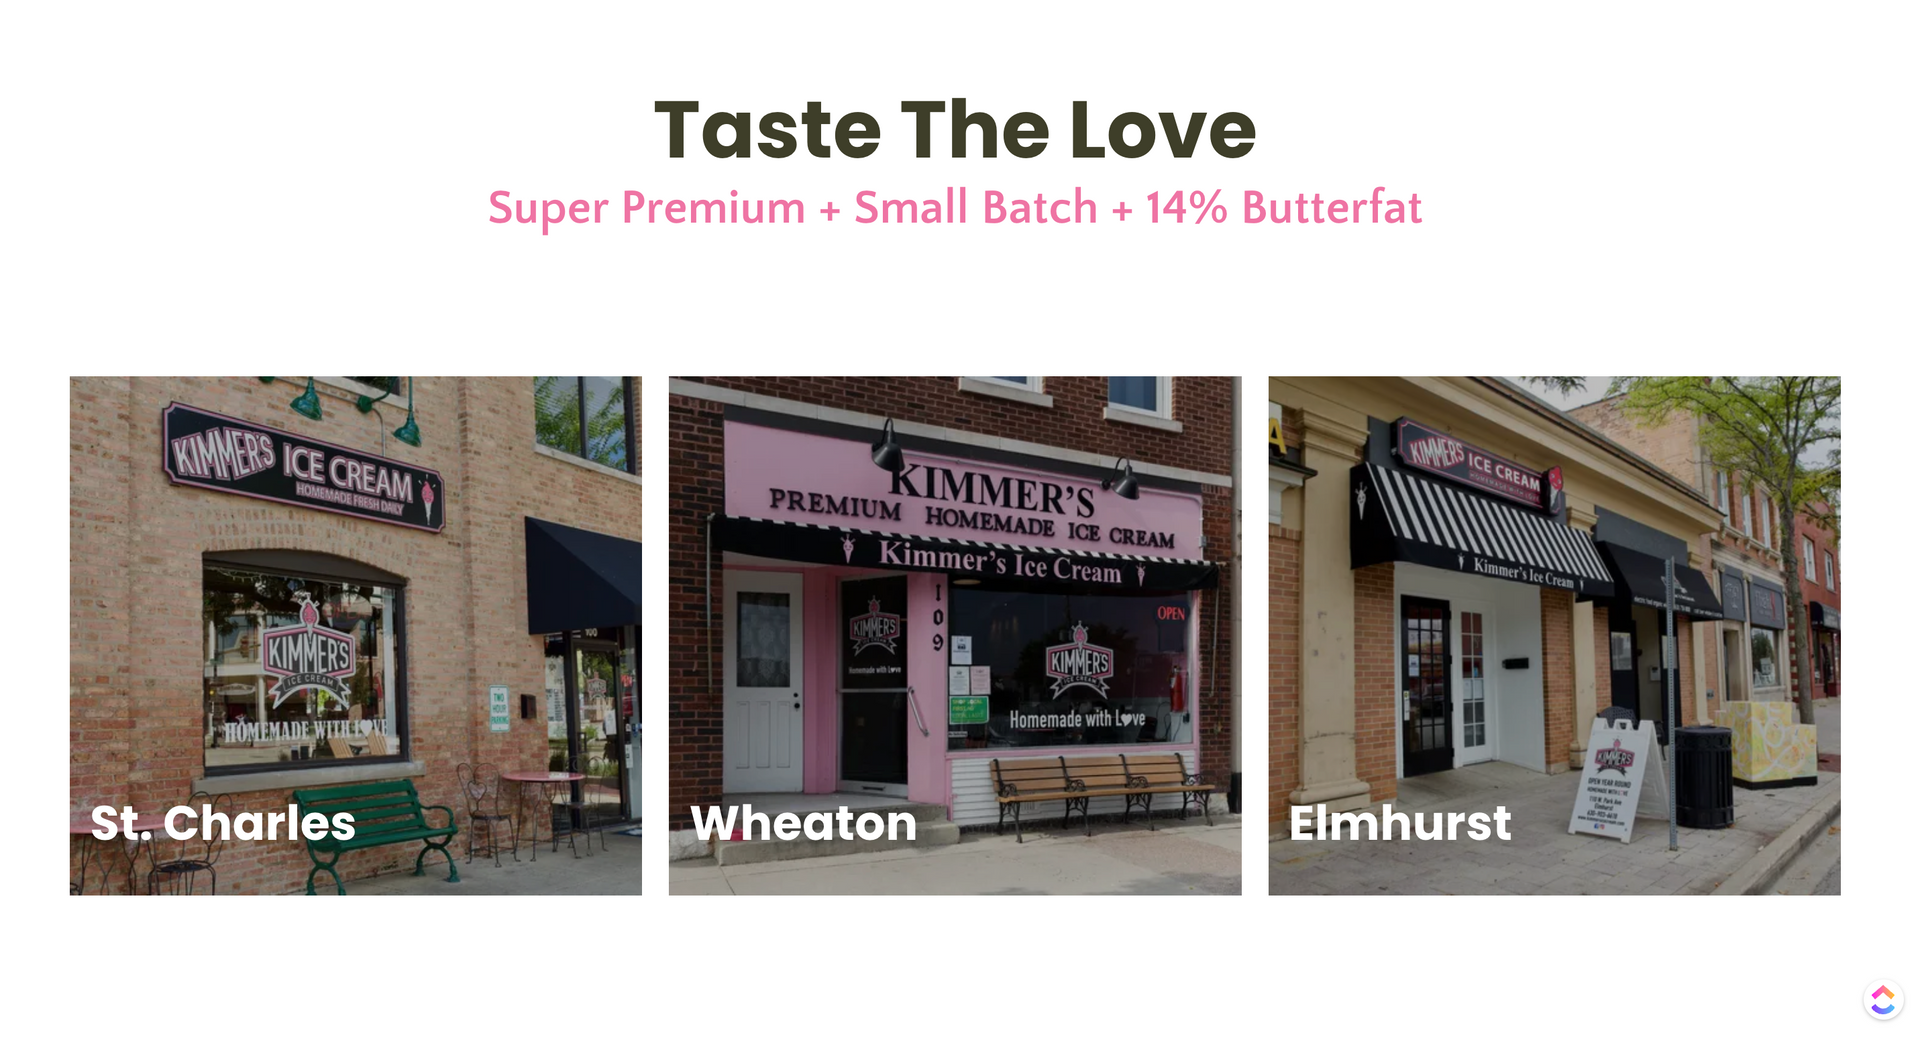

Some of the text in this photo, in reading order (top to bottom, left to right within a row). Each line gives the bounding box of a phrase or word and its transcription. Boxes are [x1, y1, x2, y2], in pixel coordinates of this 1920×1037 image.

[173, 428, 413, 503] KIMMER'S ICE CREAM
[1468, 453, 1492, 474] ICE
[1495, 464, 1541, 493] CREAM
[296, 481, 405, 517] HOMEMADE FRESH DAILY
[888, 463, 1095, 518] KIMMER'S
[769, 488, 1175, 549] PREMIUM HOMEMADE ICE CREAM
[879, 539, 1122, 584] Kimmer's Ice Cream
[1474, 557, 1574, 589] Kimmer's Ice Cream
[1157, 606, 1185, 620] OPEN
[269, 633, 349, 674] KIMMER'S
[1051, 649, 1108, 676] KIMMER'S
[288, 674, 334, 686] ICE CREAM
[1076, 676, 1097, 684] CREAM
[492, 704, 506, 714] HOUR
[493, 693, 505, 702] TWO
[224, 721, 309, 743] HOMEMADE
[314, 719, 350, 739] WITH
[491, 716, 509, 725] PARKING
[1010, 710, 1082, 729] Homemade
[1085, 709, 1112, 727] with
[1588, 777, 1600, 785] OPEN
[1614, 780, 1631, 788] ROUND
